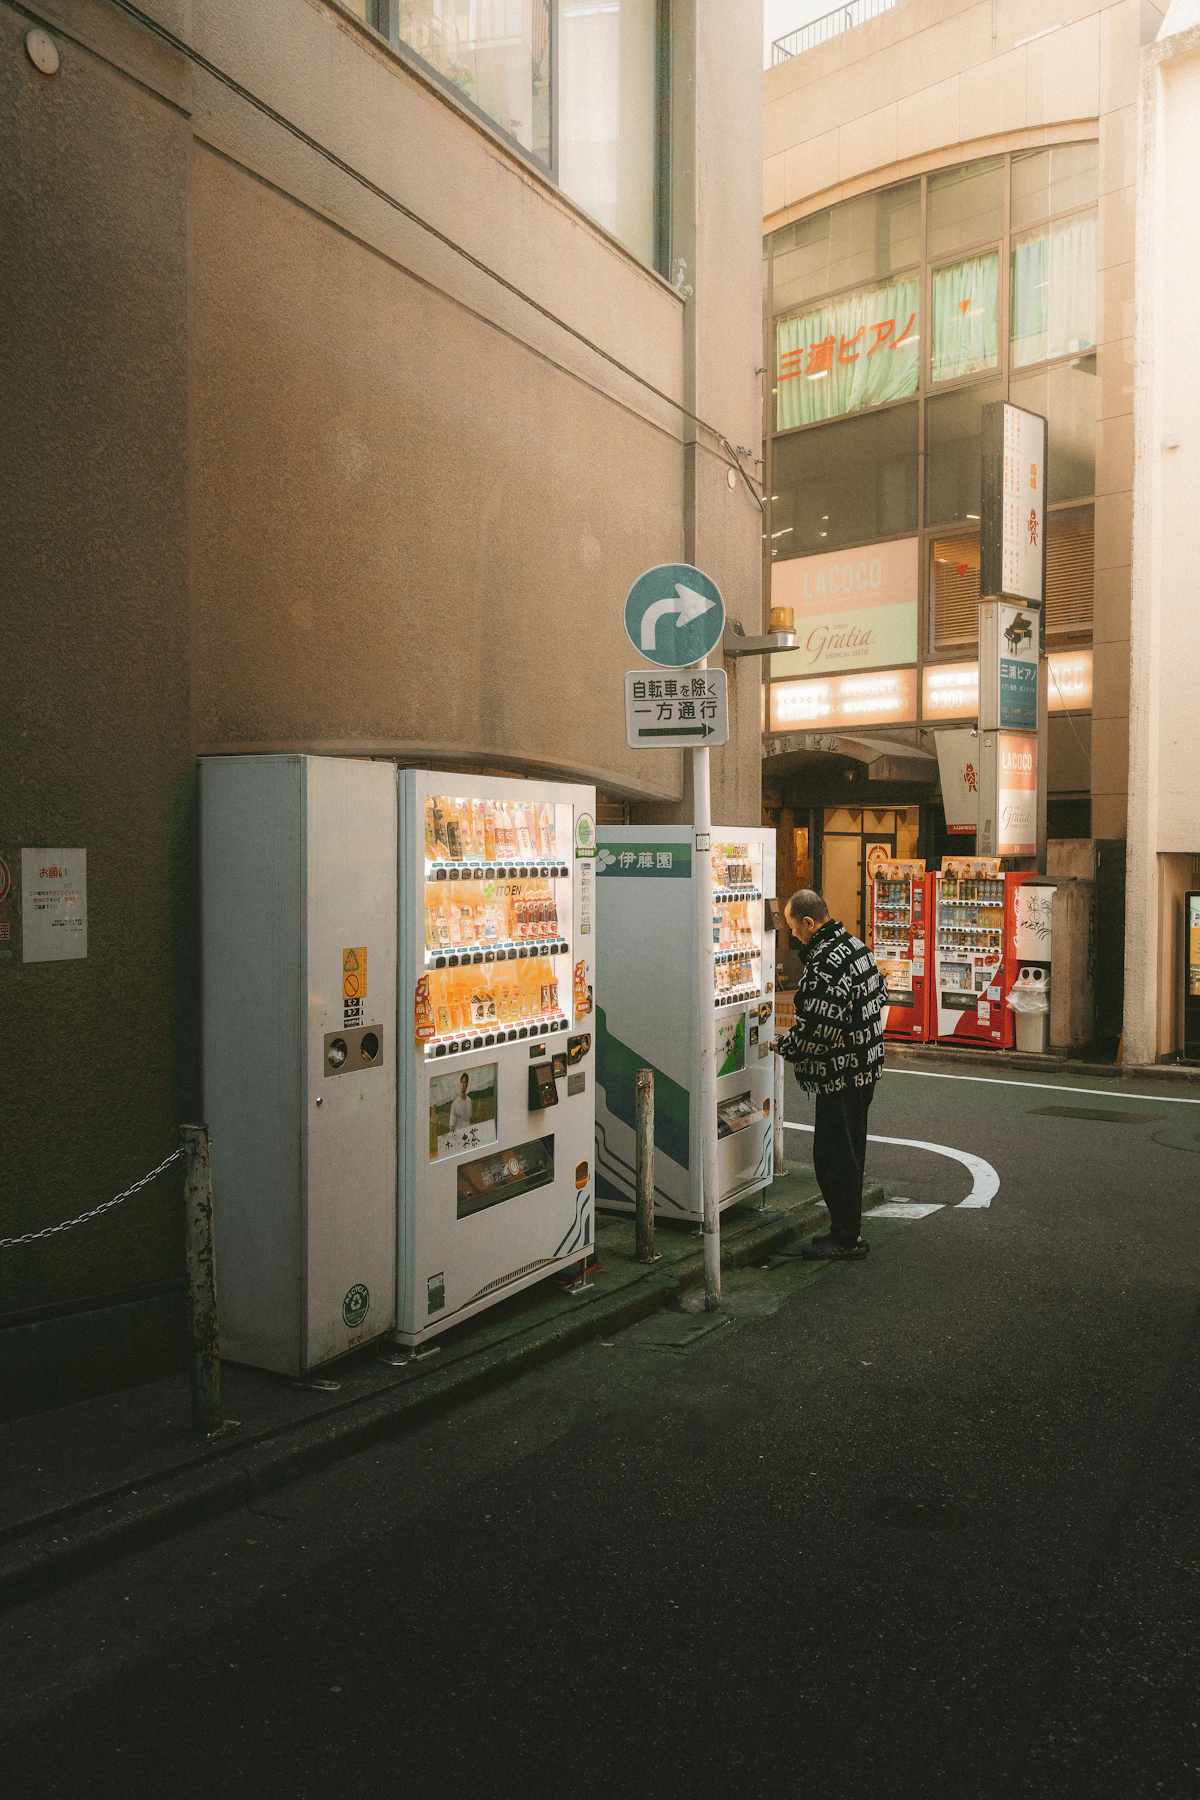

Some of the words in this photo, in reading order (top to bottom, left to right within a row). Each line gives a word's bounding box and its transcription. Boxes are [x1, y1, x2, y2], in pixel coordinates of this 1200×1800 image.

[777, 312, 916, 381] 三浦ピアノ
[803, 559, 882, 599] LACOCO
[1000, 664, 1037, 681] 三浦ピアノ
[633, 678, 717, 699] 自転車を除く
[634, 701, 718, 721] 一方通行
[1002, 752, 1033, 771] LACOCO
[618, 851, 673, 869] 伊藤園
[40, 867, 68, 879] お願い
[495, 885, 511, 897] ITO
[511, 885, 522, 896] EN
[826, 942, 853, 969] 1975
[830, 1053, 859, 1073] 1975
[345, 1285, 368, 1304] RECYCLE
